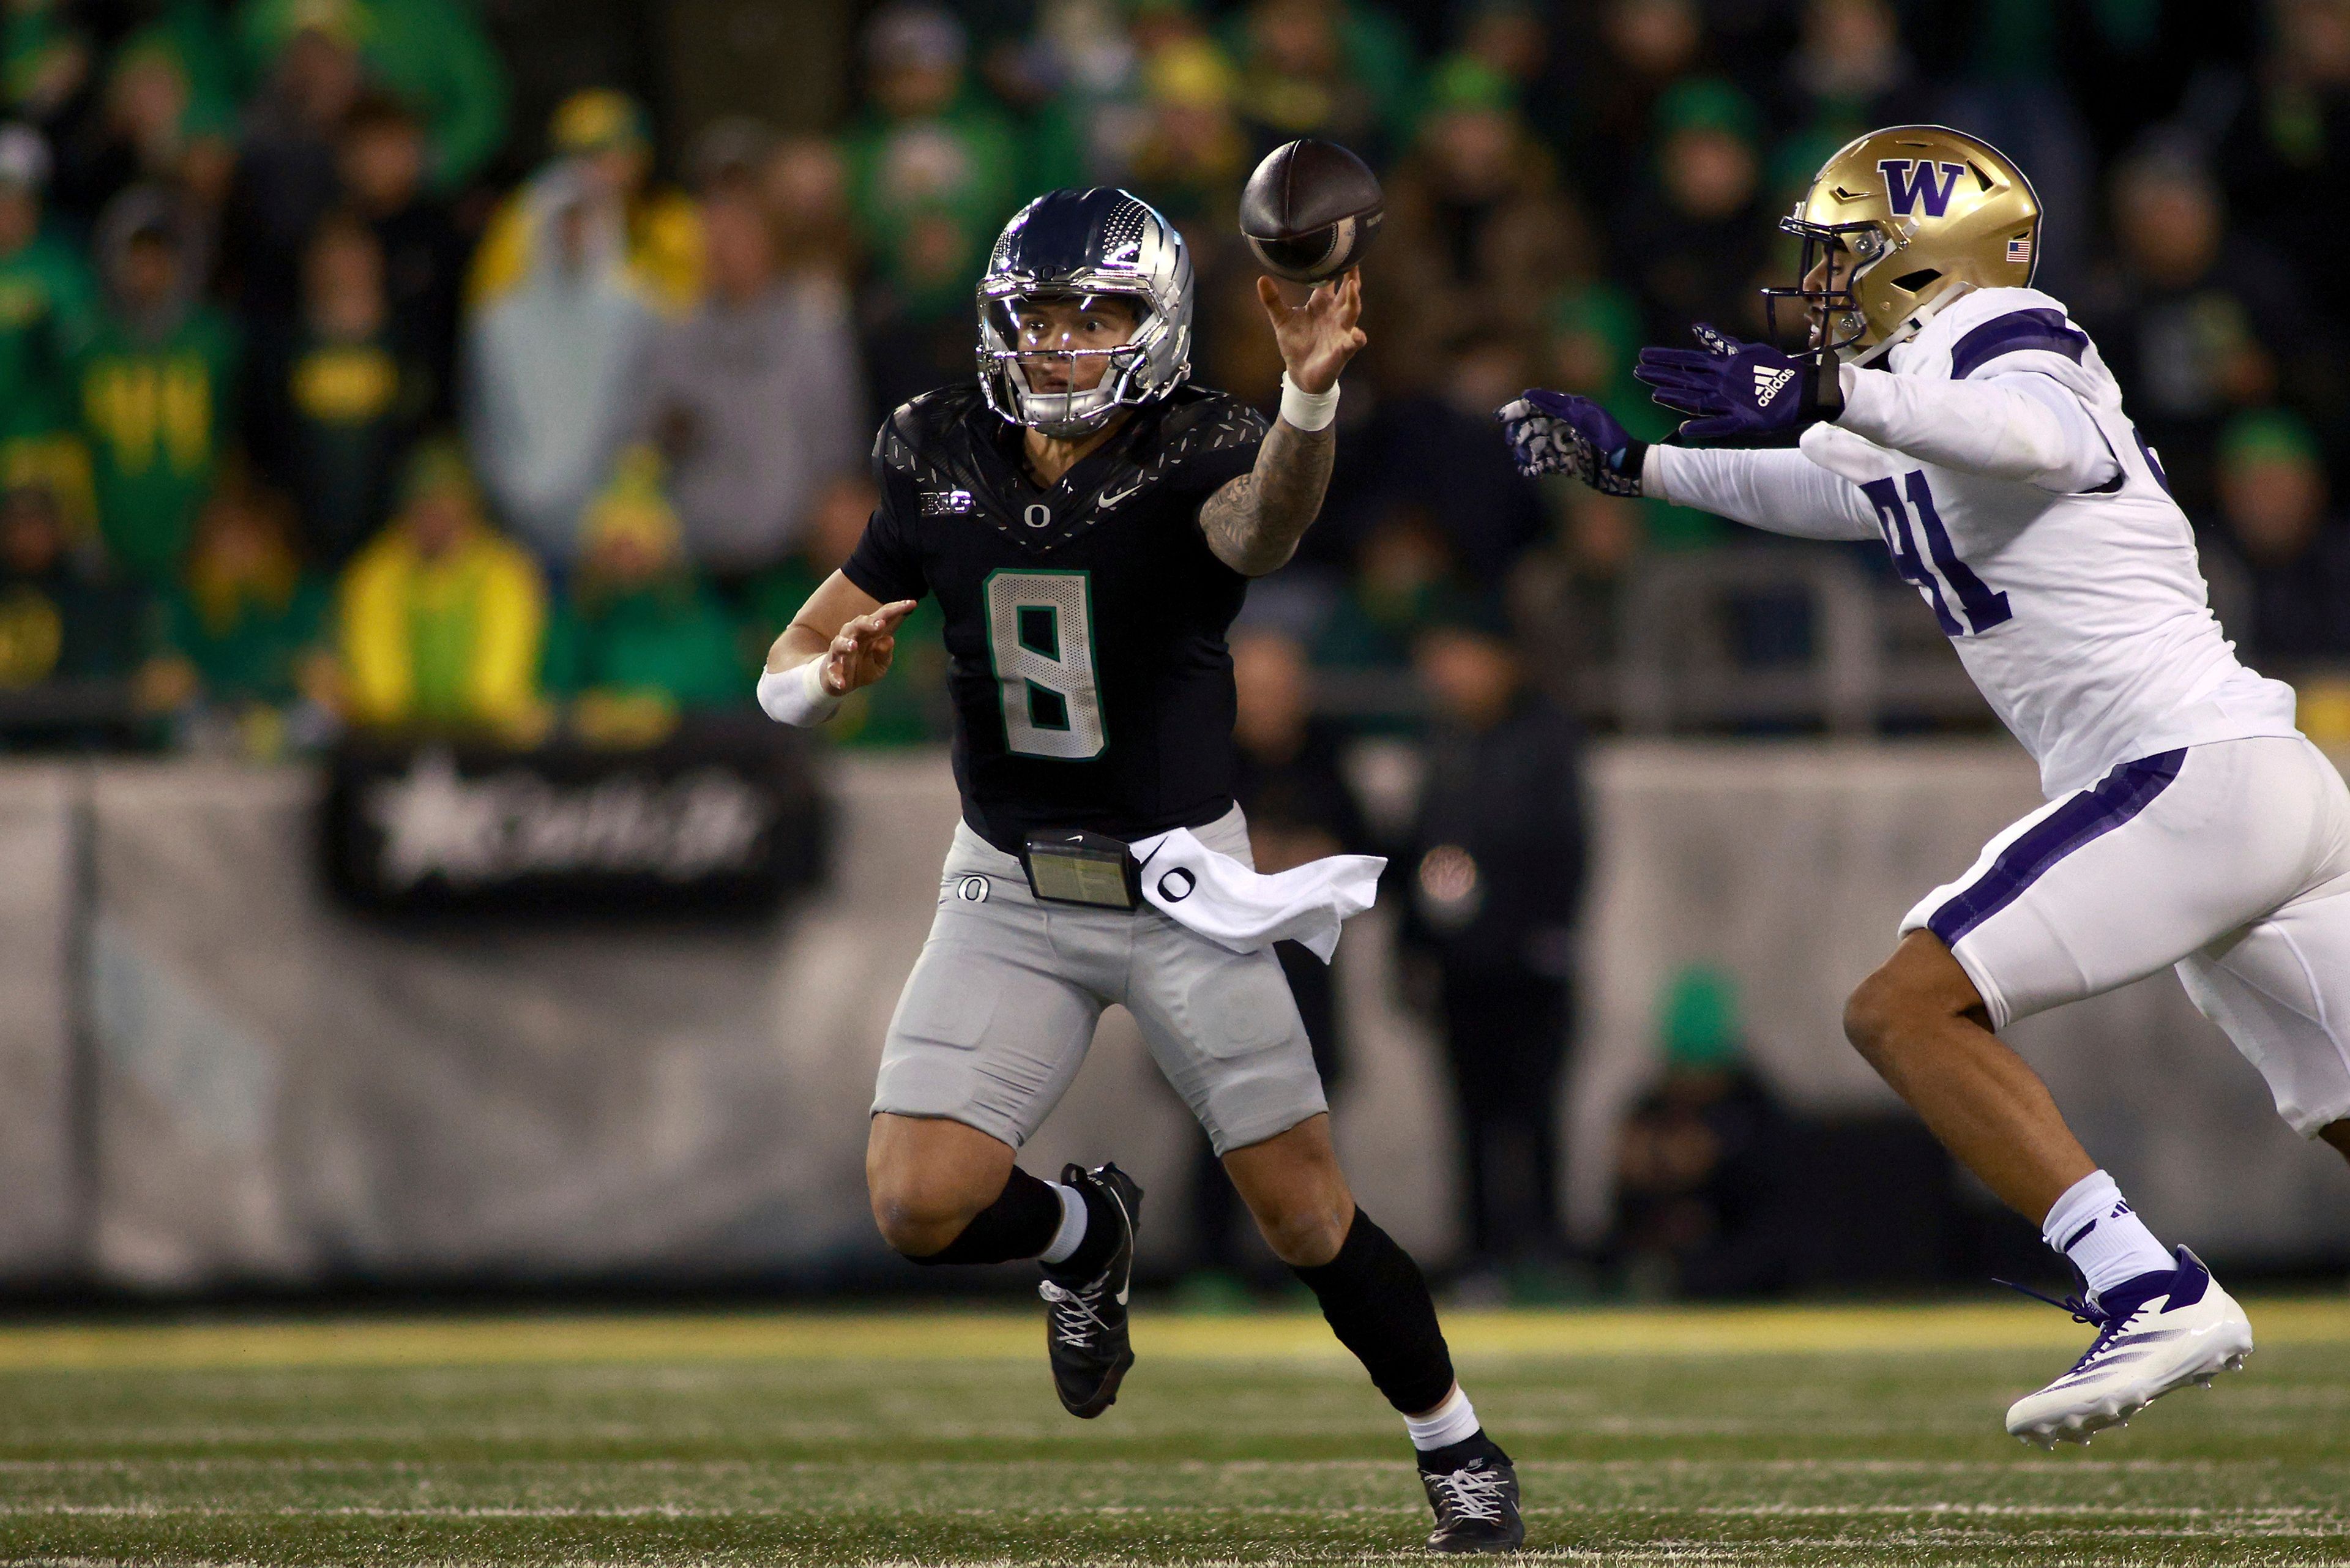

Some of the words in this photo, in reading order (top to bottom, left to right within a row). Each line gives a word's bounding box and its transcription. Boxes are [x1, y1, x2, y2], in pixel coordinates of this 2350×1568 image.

[1877, 159, 1966, 218] W
[1758, 368, 1796, 407] adidas
[1024, 504, 1051, 528] O
[982, 567, 1110, 763] 8
[958, 875, 990, 903] O
[1157, 867, 1196, 903] O
